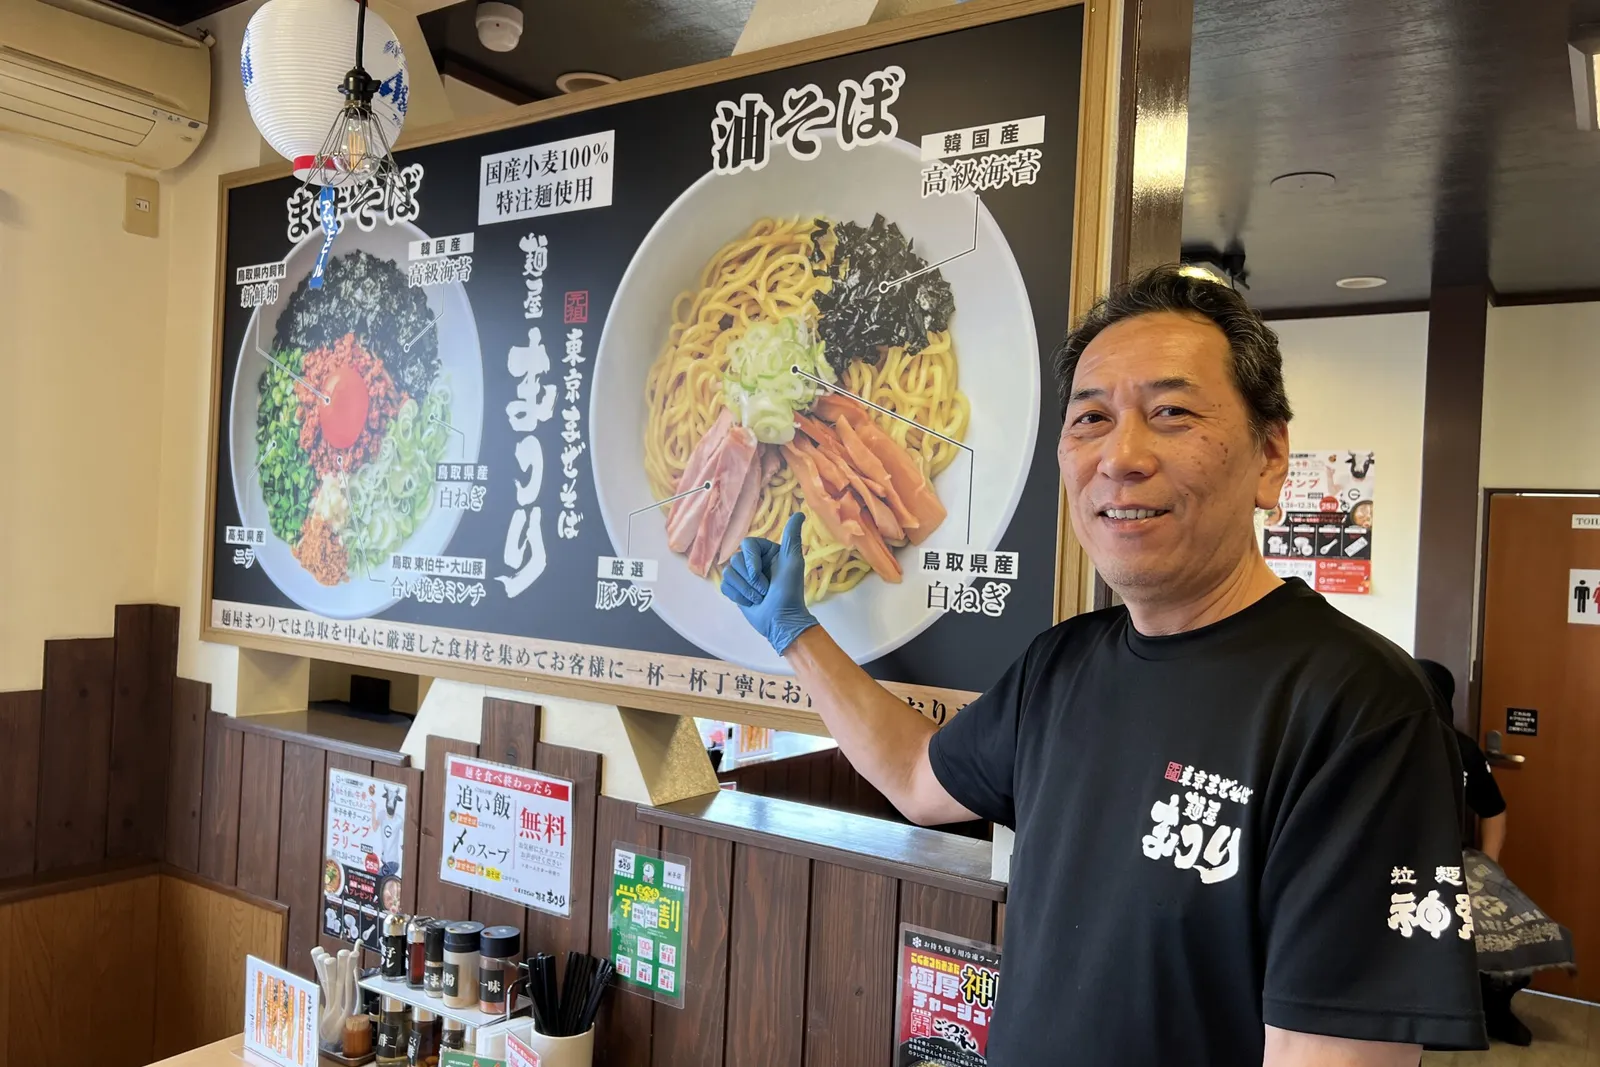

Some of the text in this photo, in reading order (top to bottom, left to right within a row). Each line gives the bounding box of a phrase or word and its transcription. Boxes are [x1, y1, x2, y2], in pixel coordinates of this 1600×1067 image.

[711, 65, 906, 175] 油そば
[944, 124, 1019, 154] 韓国産
[485, 142, 608, 186] 国産小麦100%
[921, 149, 1043, 198] 高級海苔
[496, 176, 593, 215] 特注麺使用
[312, 199, 336, 279] アサヒビール
[420, 237, 461, 257] 韓国産
[237, 263, 287, 283] 鳥取県内飼育
[408, 256, 473, 288] 高級海苔
[240, 284, 279, 308] 新鮮卵
[558, 328, 587, 539] 東京まぜそば
[437, 465, 488, 481] 鳥取県産
[439, 485, 487, 512] 白ねぎ
[227, 528, 265, 544] 高知県産
[232, 548, 257, 569] ニラ
[611, 559, 644, 578] 厳選
[922, 551, 1014, 575] 鳥取県産
[391, 576, 486, 607] 合い挽きミンチ
[595, 581, 655, 612] 豚バラ
[926, 580, 1011, 617] 白ねぎ
[465, 767, 552, 796] 麺を食べ終わったら
[1178, 765, 1254, 805] 東京まぜそば
[456, 784, 512, 820] 追い飯
[332, 818, 371, 838] スタンプ
[332, 833, 359, 849] ラリー
[519, 806, 567, 847] 無料
[1142, 794, 1242, 885] まつり
[453, 828, 510, 864] 〆のスープ
[480, 979, 501, 994] 一味
[910, 965, 960, 1000] 極厚
[960, 964, 999, 1010] 神
[913, 990, 992, 1027] チャーシュ
